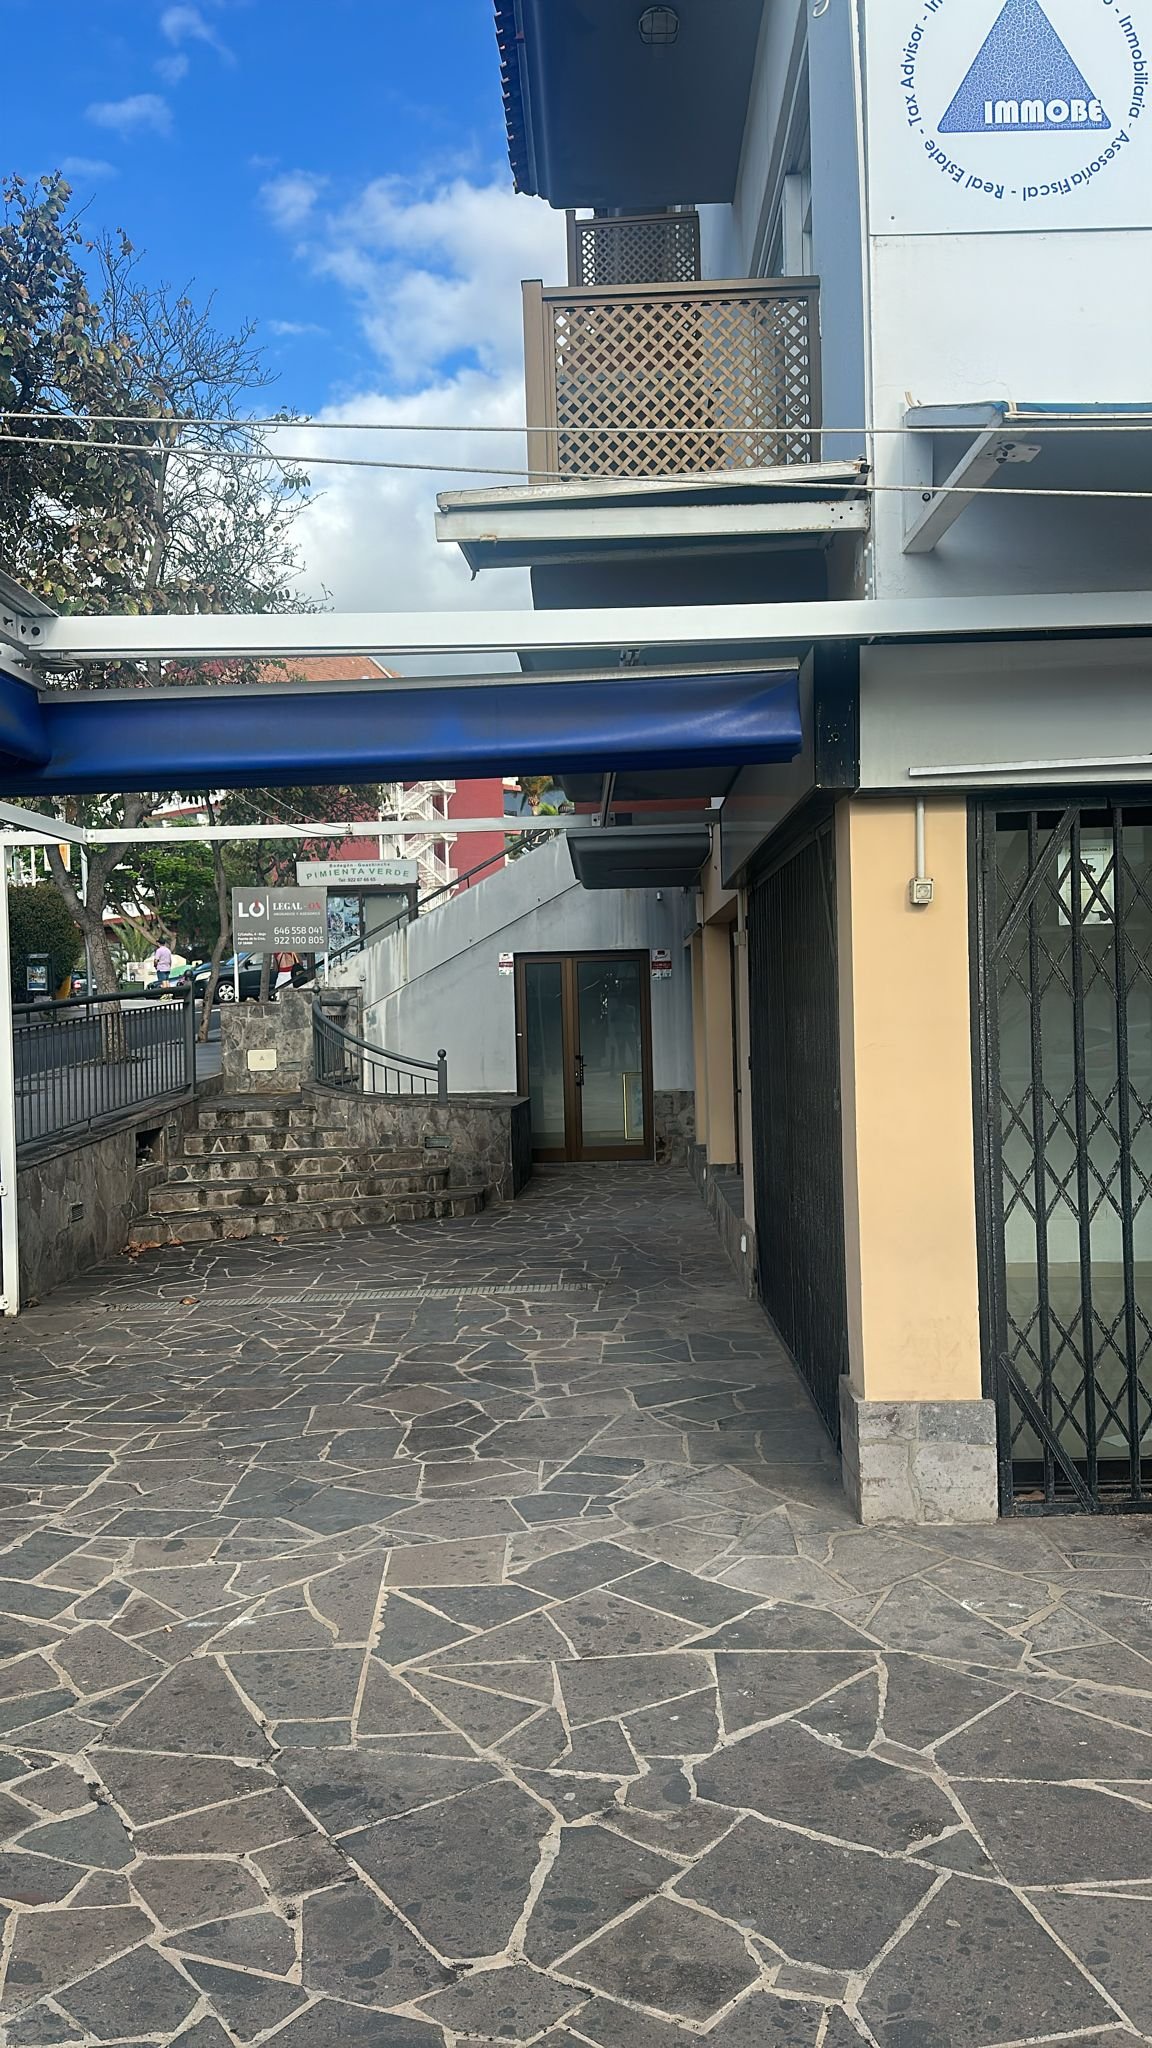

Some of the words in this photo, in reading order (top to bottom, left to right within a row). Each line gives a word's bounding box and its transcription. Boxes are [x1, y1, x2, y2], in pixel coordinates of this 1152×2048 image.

[900, 23, 925, 89] Advisor
[1118, 15, 1149, 119] Inmobiliaria
[905, 94, 922, 127] Tax
[983, 98, 1103, 124] IMMOBE
[924, 139, 965, 183] Estate
[1072, 130, 1131, 185] Asesoría
[964, 175, 1005, 200] Real
[1022, 178, 1072, 201] Fiscal
[306, 868, 365, 880] PIMIENTA
[369, 868, 409, 877] VERDE
[272, 902, 302, 911] LEGAL
[274, 926, 290, 935] 646
[291, 926, 306, 935] 558
[308, 926, 323, 934] 041
[274, 936, 290, 945] 922
[291, 936, 307, 945] 100
[308, 936, 324, 944] 805
